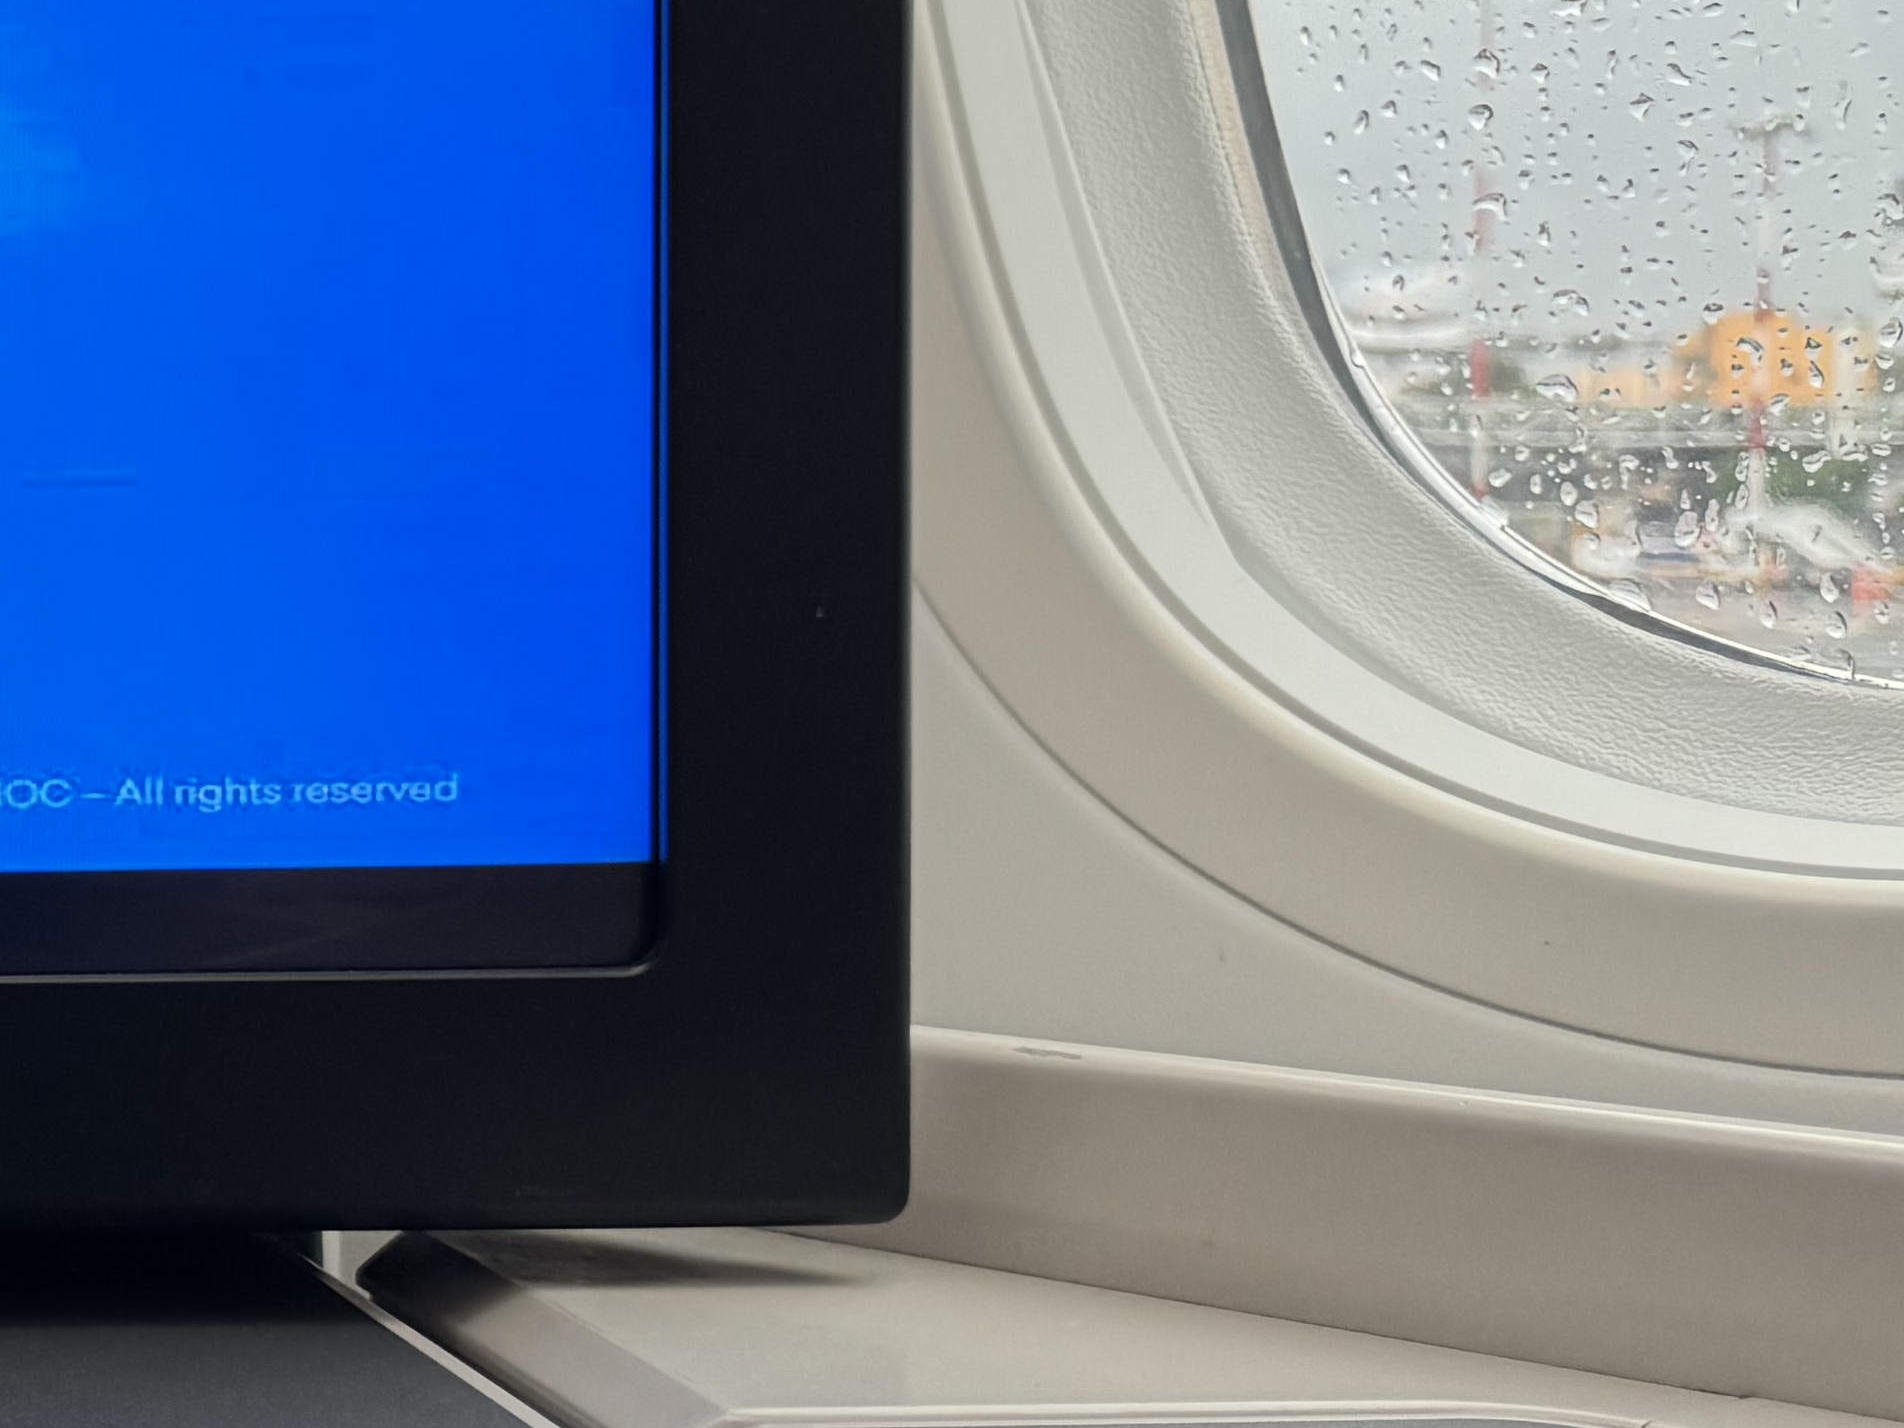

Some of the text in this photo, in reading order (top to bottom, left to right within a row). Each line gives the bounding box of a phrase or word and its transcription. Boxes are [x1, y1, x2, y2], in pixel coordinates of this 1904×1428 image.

[115, 777, 164, 806] All
[174, 777, 282, 812] rights
[293, 773, 457, 805] reserved
